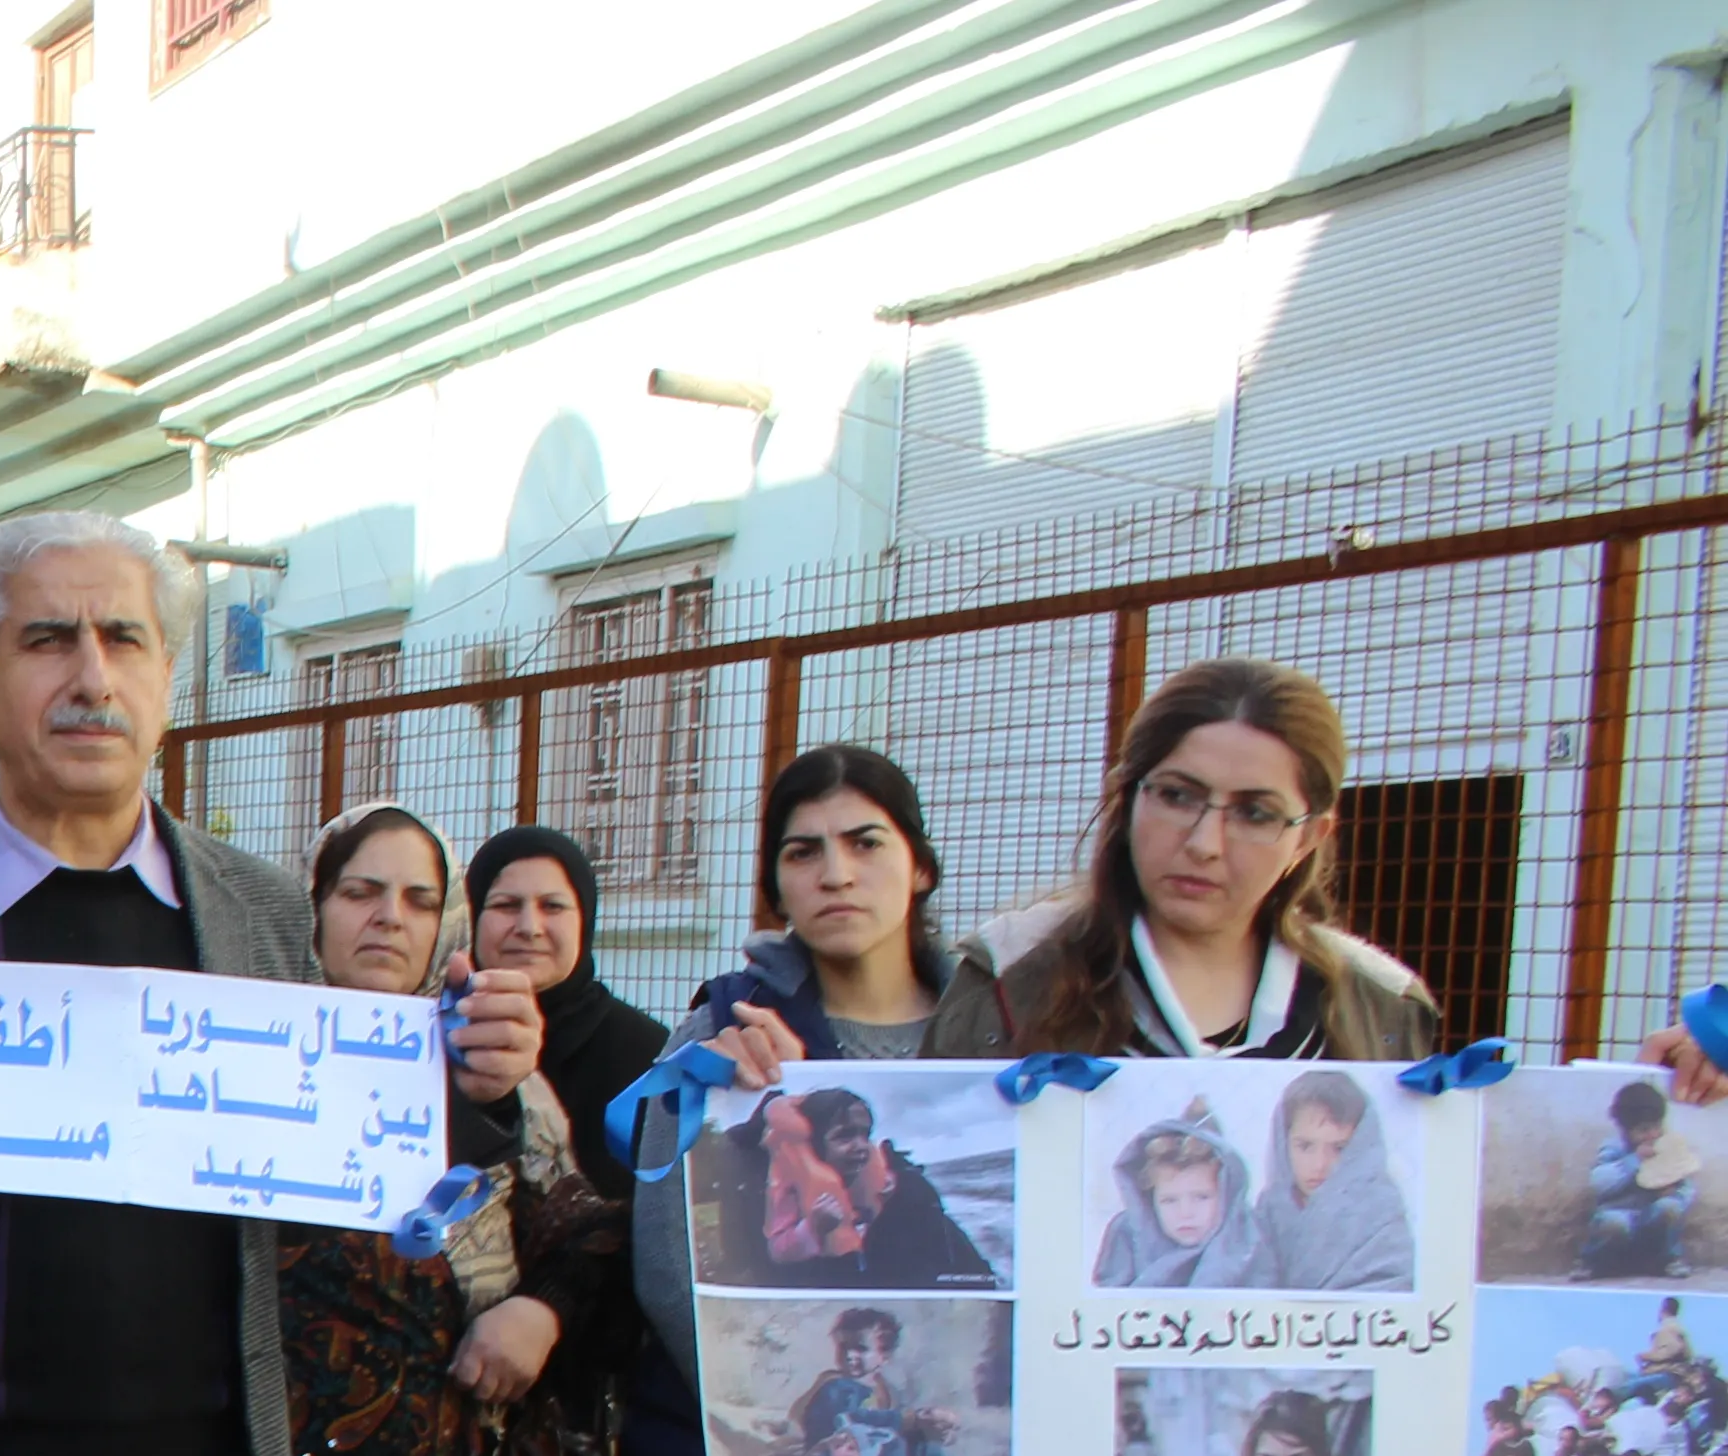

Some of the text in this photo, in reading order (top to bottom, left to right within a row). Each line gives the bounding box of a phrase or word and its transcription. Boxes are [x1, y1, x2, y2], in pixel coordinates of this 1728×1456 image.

[140, 985, 292, 1054] سوريا
[299, 1004, 439, 1066] أطفال
[138, 1067, 318, 1125] شاهد
[361, 1088, 432, 1158] بين
[192, 1146, 384, 1220] وشهيد
[1409, 1302, 1457, 1354] كل
